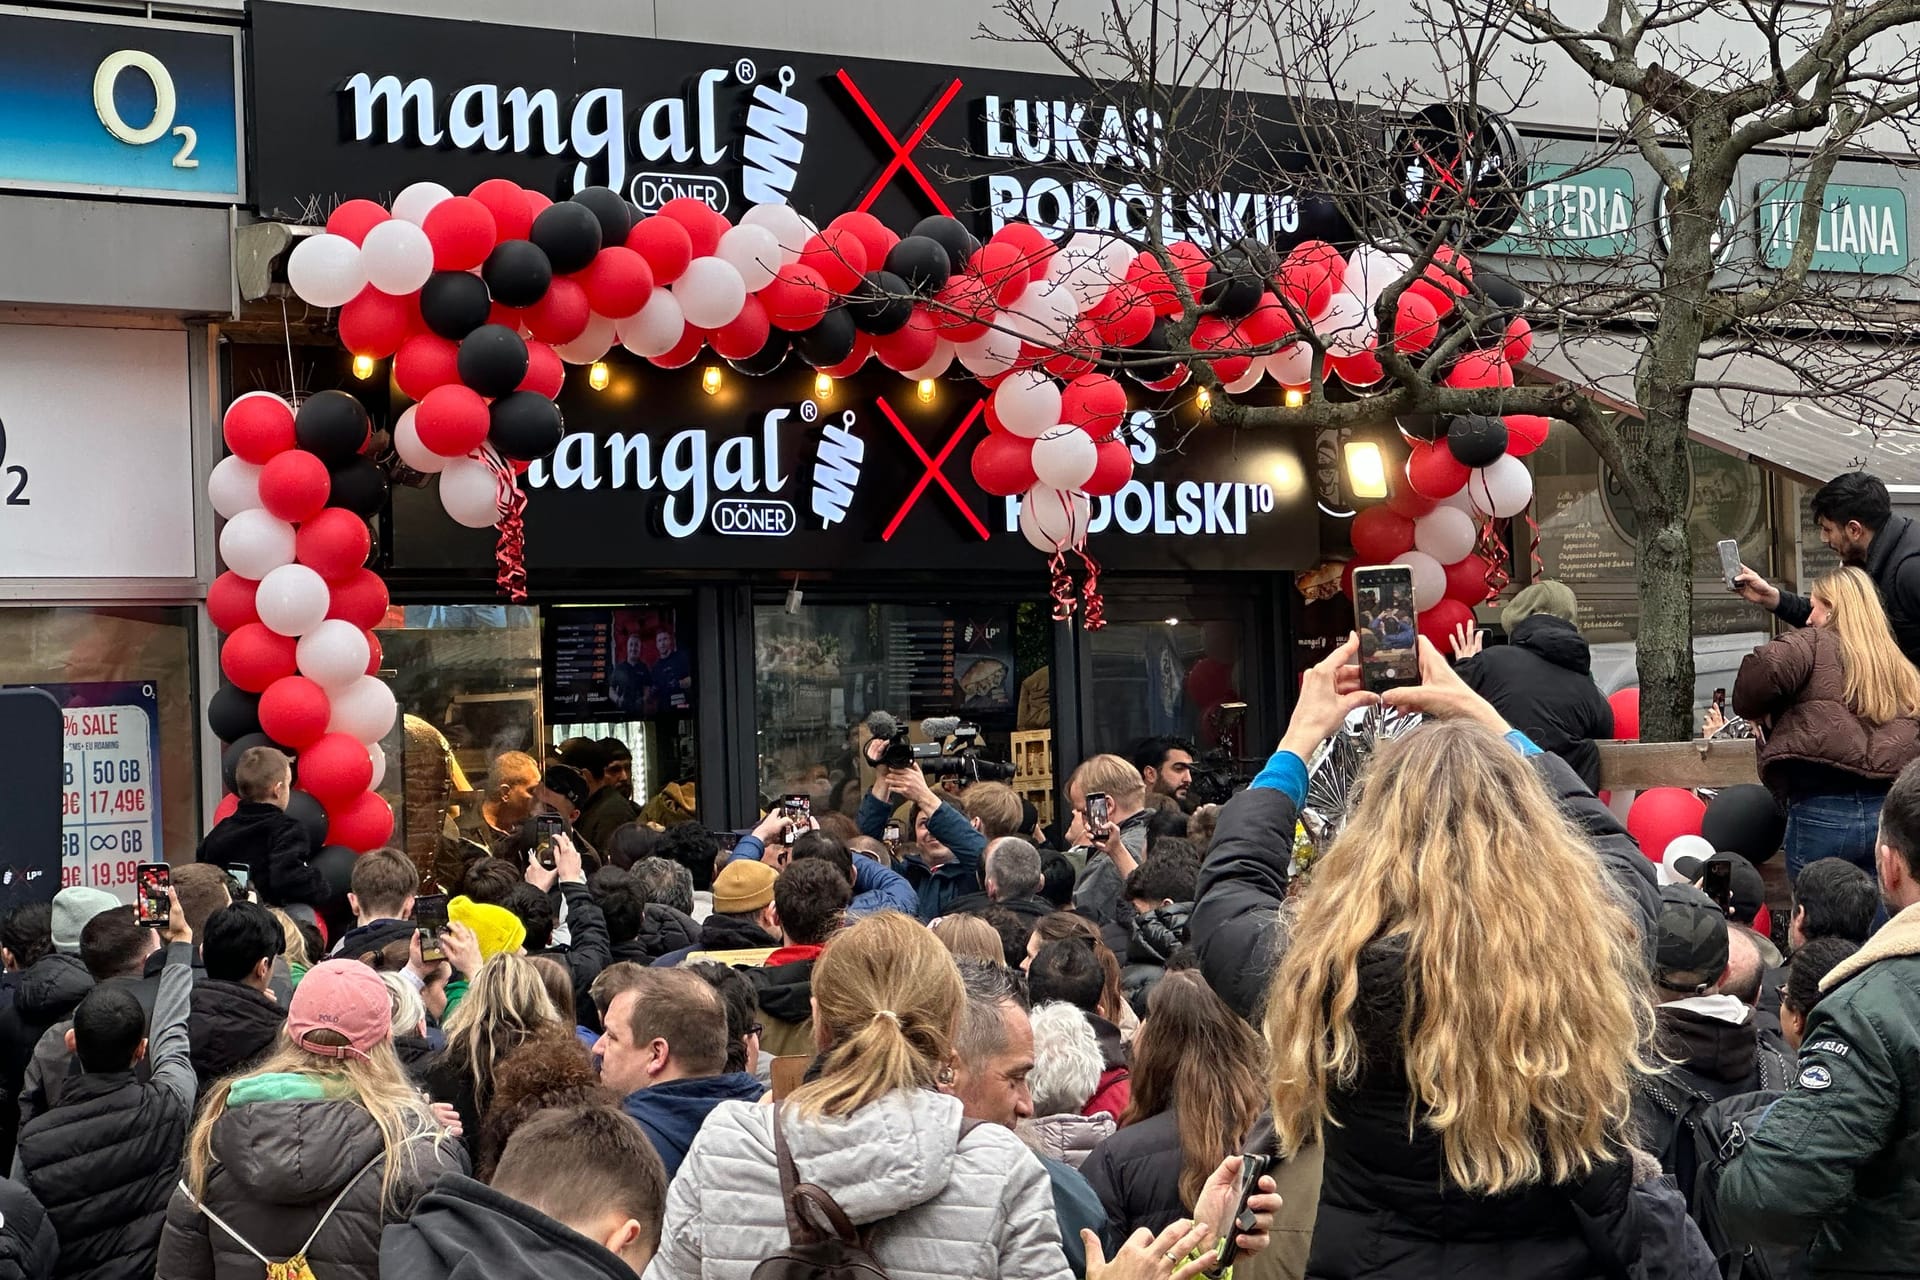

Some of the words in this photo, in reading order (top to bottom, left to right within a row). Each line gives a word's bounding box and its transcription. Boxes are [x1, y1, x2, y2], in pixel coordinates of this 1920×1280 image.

[93, 50, 199, 168] O2
[345, 68, 728, 197] mangal
[985, 95, 1163, 168] LUKAS
[642, 178, 719, 211] DÖNER
[1771, 199, 1899, 256] ITLIANA
[0, 417, 30, 505] 2
[528, 409, 791, 538] angal
[721, 503, 787, 532] DÖNER
[142, 684, 156, 699] O2
[82, 713, 119, 736] SALE
[94, 741, 119, 750] ROAMING
[92, 760, 115, 784] 50
[119, 759, 141, 783] GB
[90, 788, 146, 816] 17,49€
[121, 829, 143, 853] GB
[91, 860, 143, 886] 19,99
[318, 1014, 339, 1023] POLO
